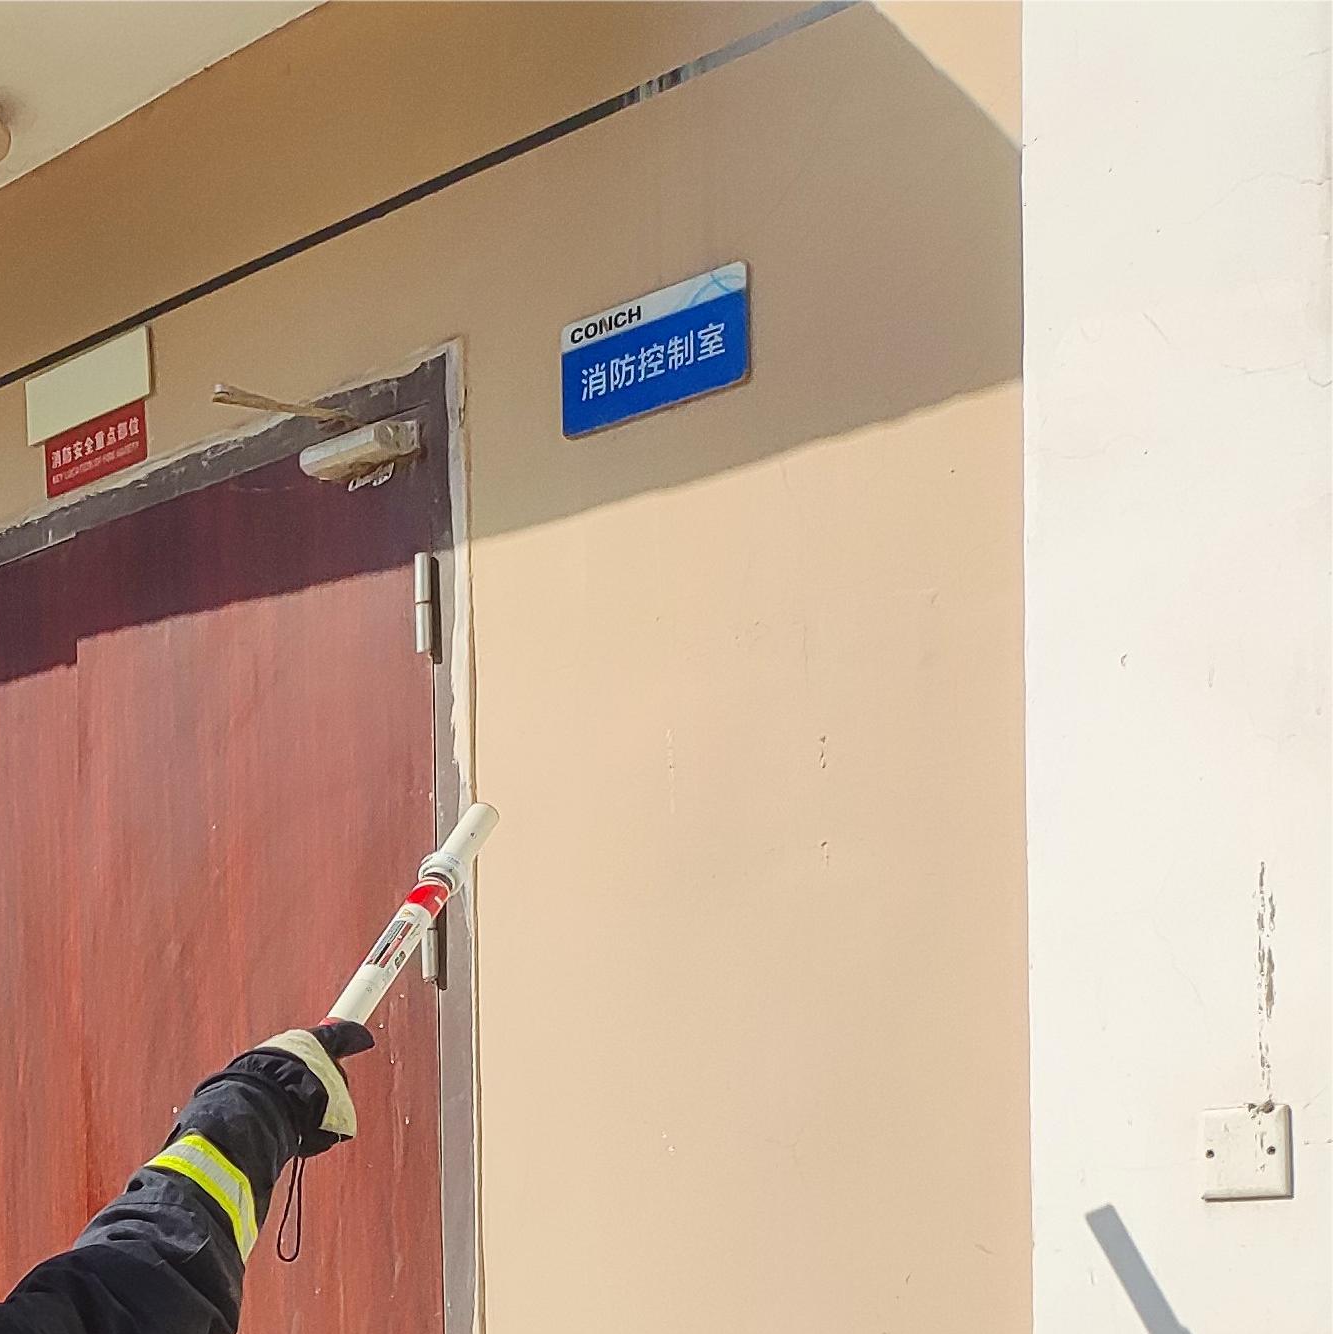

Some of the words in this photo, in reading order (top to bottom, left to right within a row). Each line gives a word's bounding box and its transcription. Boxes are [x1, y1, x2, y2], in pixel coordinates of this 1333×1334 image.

[570, 305, 642, 345] CONCH
[581, 321, 726, 402] 消防控制室
